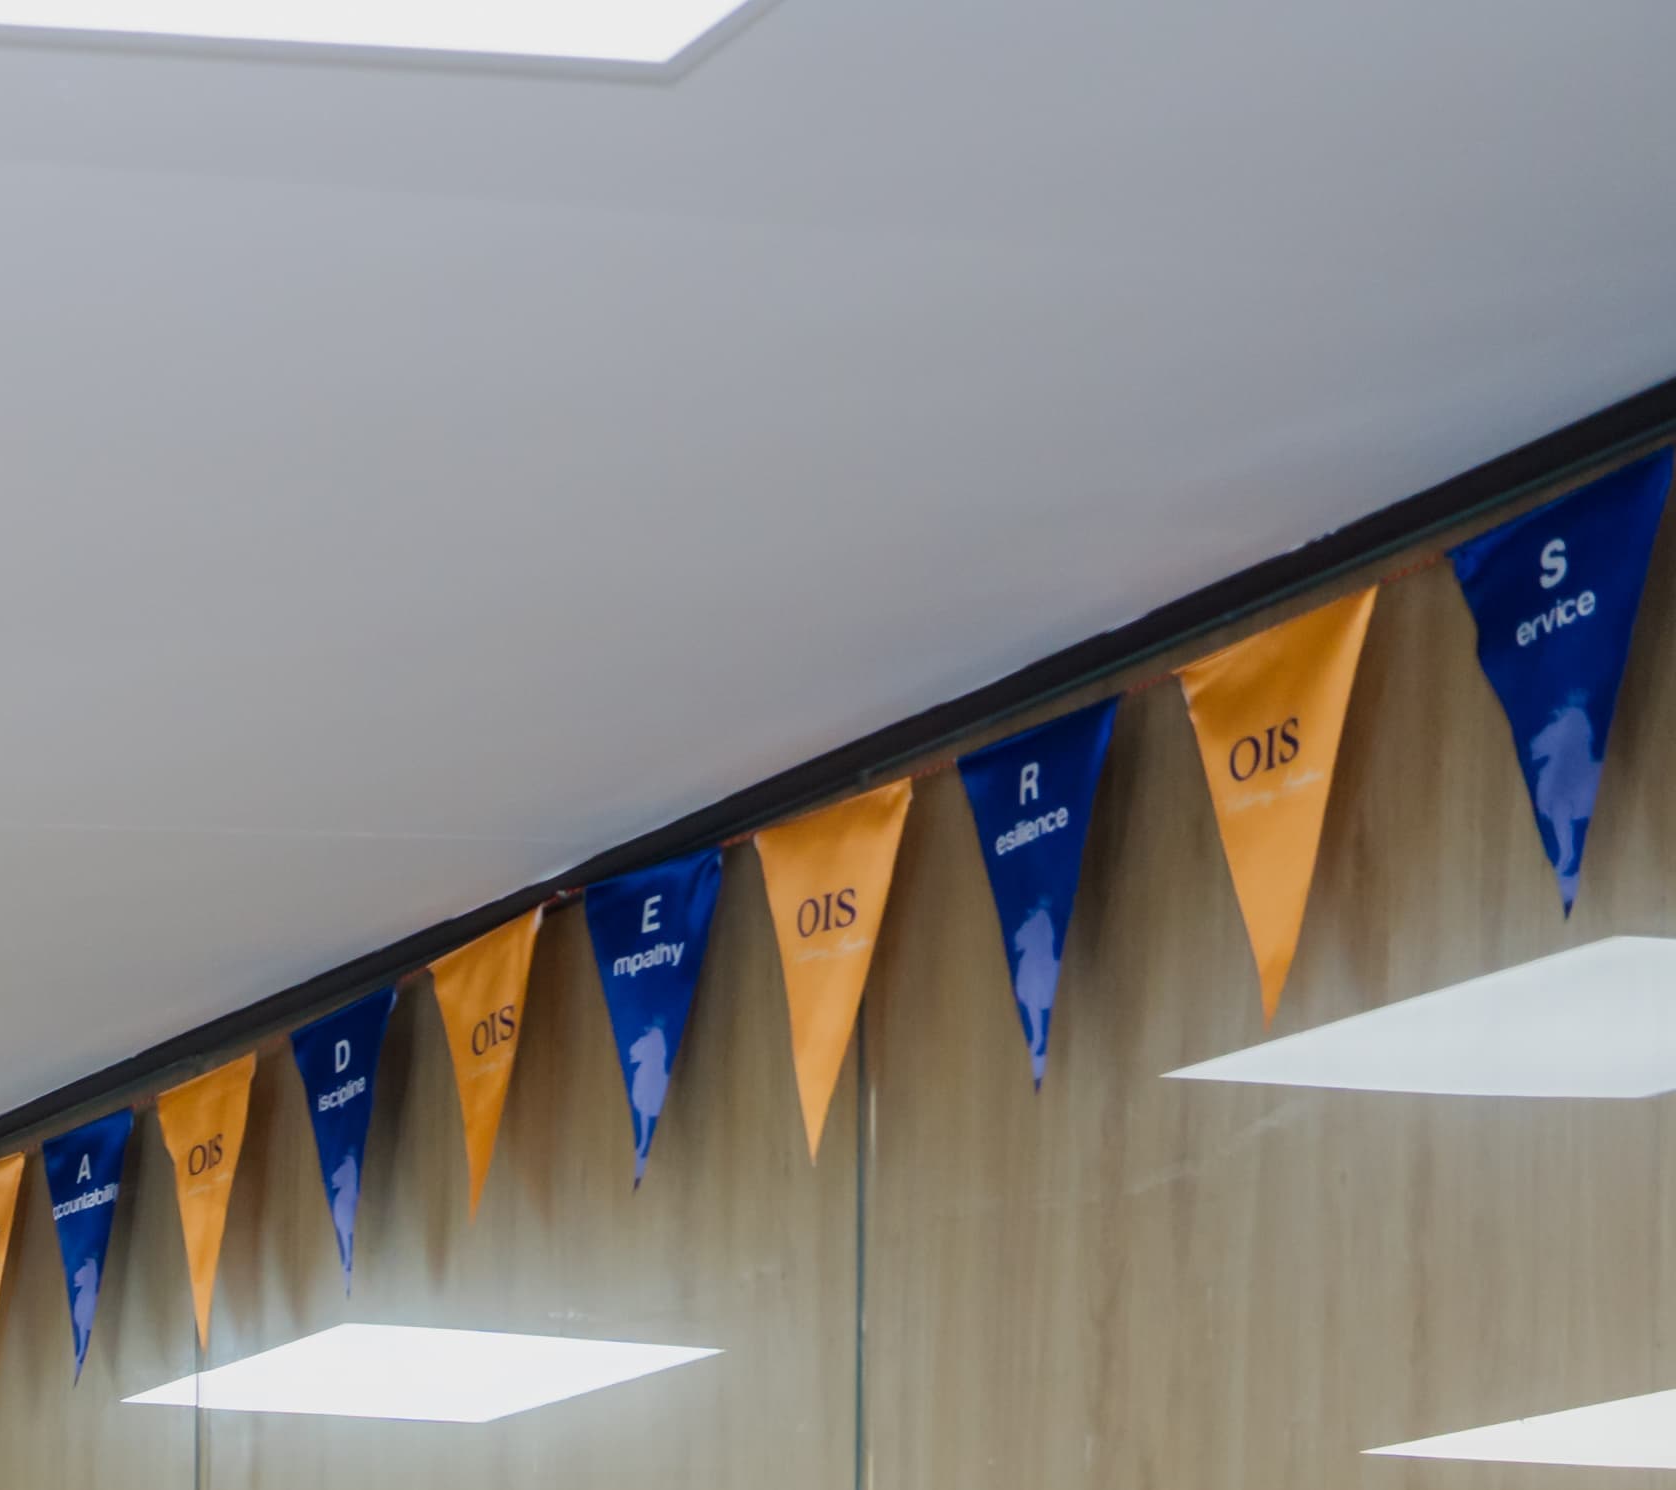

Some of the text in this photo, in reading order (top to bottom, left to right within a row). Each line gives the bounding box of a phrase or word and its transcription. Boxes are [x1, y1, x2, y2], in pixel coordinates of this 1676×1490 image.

[1539, 537, 1567, 590] S
[1516, 589, 1597, 648] ervice
[1228, 715, 1300, 783] OIS
[1019, 762, 1039, 805] R
[994, 806, 1069, 857] esilience
[640, 894, 663, 934] E
[797, 887, 857, 938] OIS
[612, 941, 685, 978] mpathy
[472, 1004, 516, 1057] OIS
[334, 1039, 351, 1074] D
[76, 1152, 92, 1185] A
[188, 1133, 224, 1176] OIS
